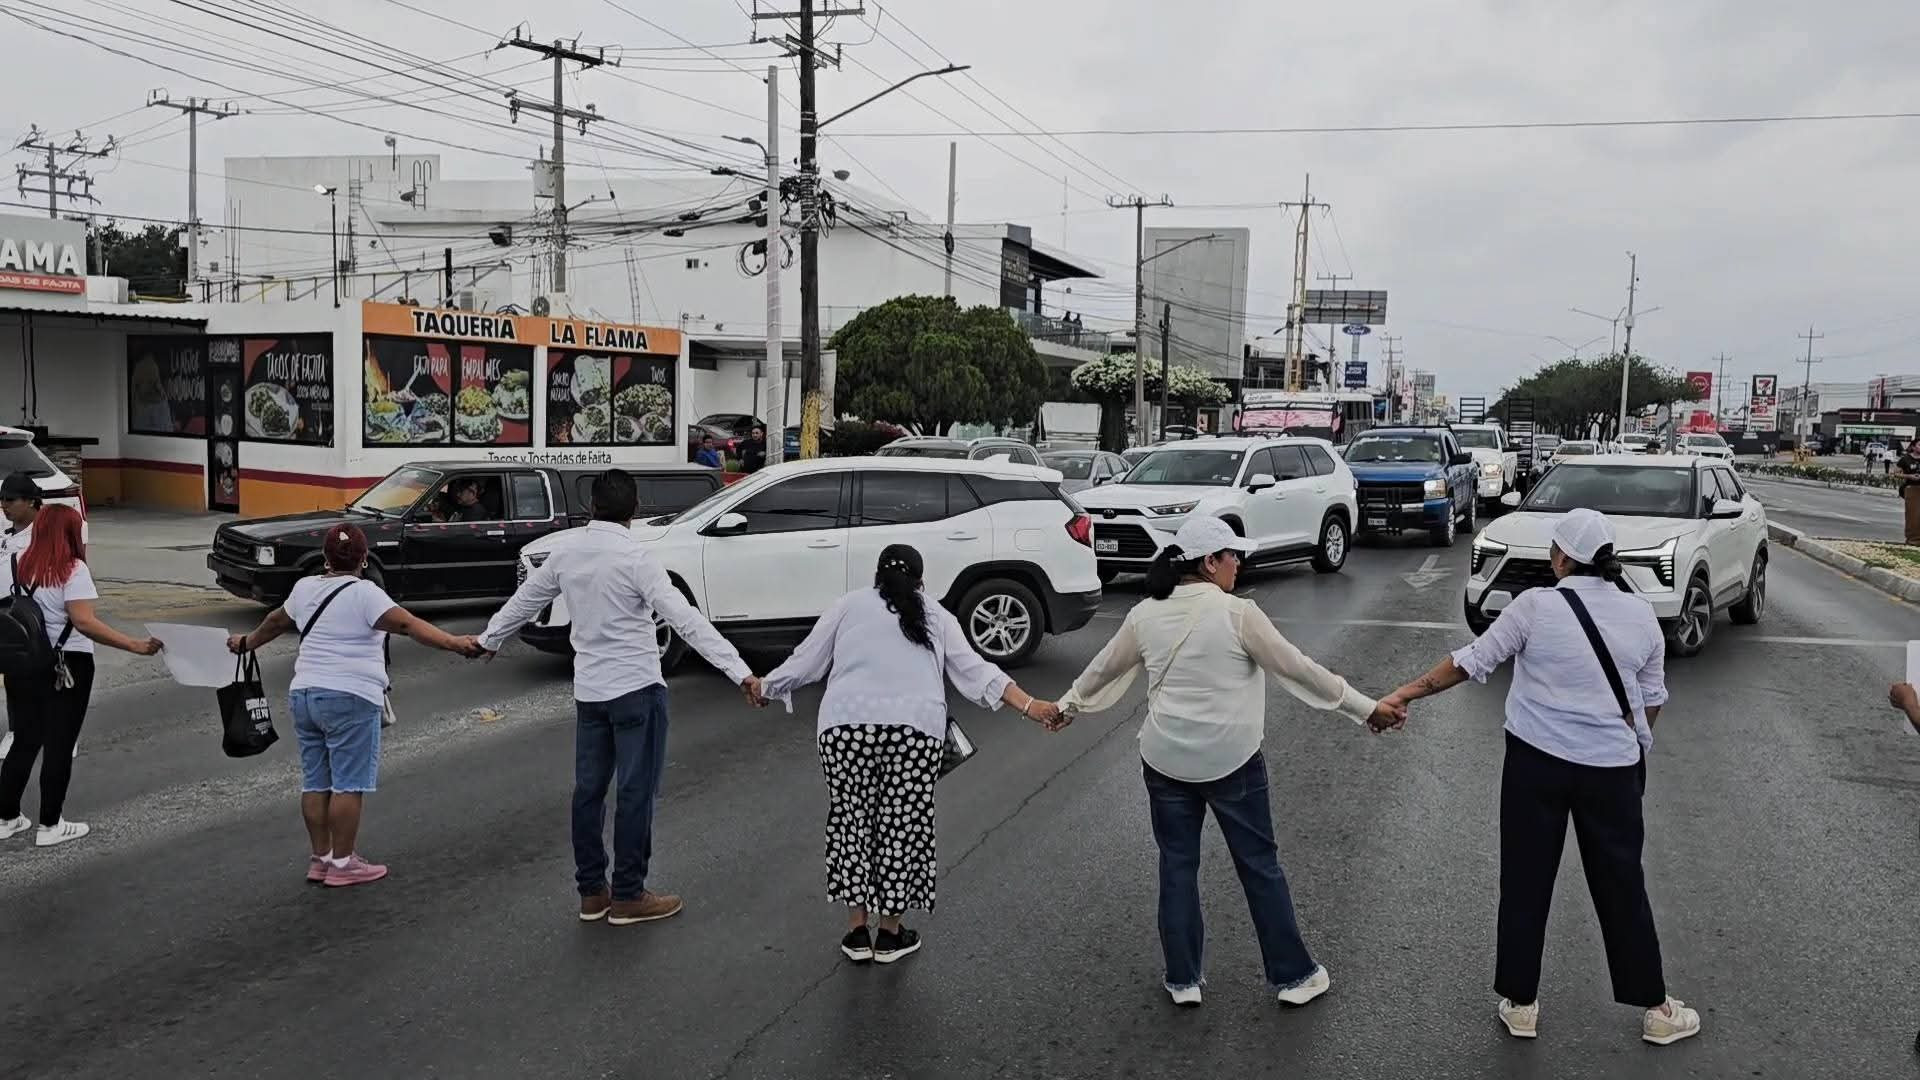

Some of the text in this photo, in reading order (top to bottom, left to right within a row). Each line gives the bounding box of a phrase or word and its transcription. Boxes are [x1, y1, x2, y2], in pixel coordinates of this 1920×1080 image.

[0, 239, 80, 274] AMA
[23, 278, 40, 286] DE
[42, 279, 81, 289] FAJITA
[412, 311, 515, 339] TAQUERIA
[551, 323, 648, 350] LA FLAMA
[266, 352, 290, 380] TACOS
[290, 352, 301, 381] DE
[301, 353, 327, 382] FAJITA
[462, 356, 501, 382] EMPALMES
[488, 451, 518, 463] Tacos
[528, 451, 574, 465] Tostadas
[575, 450, 587, 465] de
